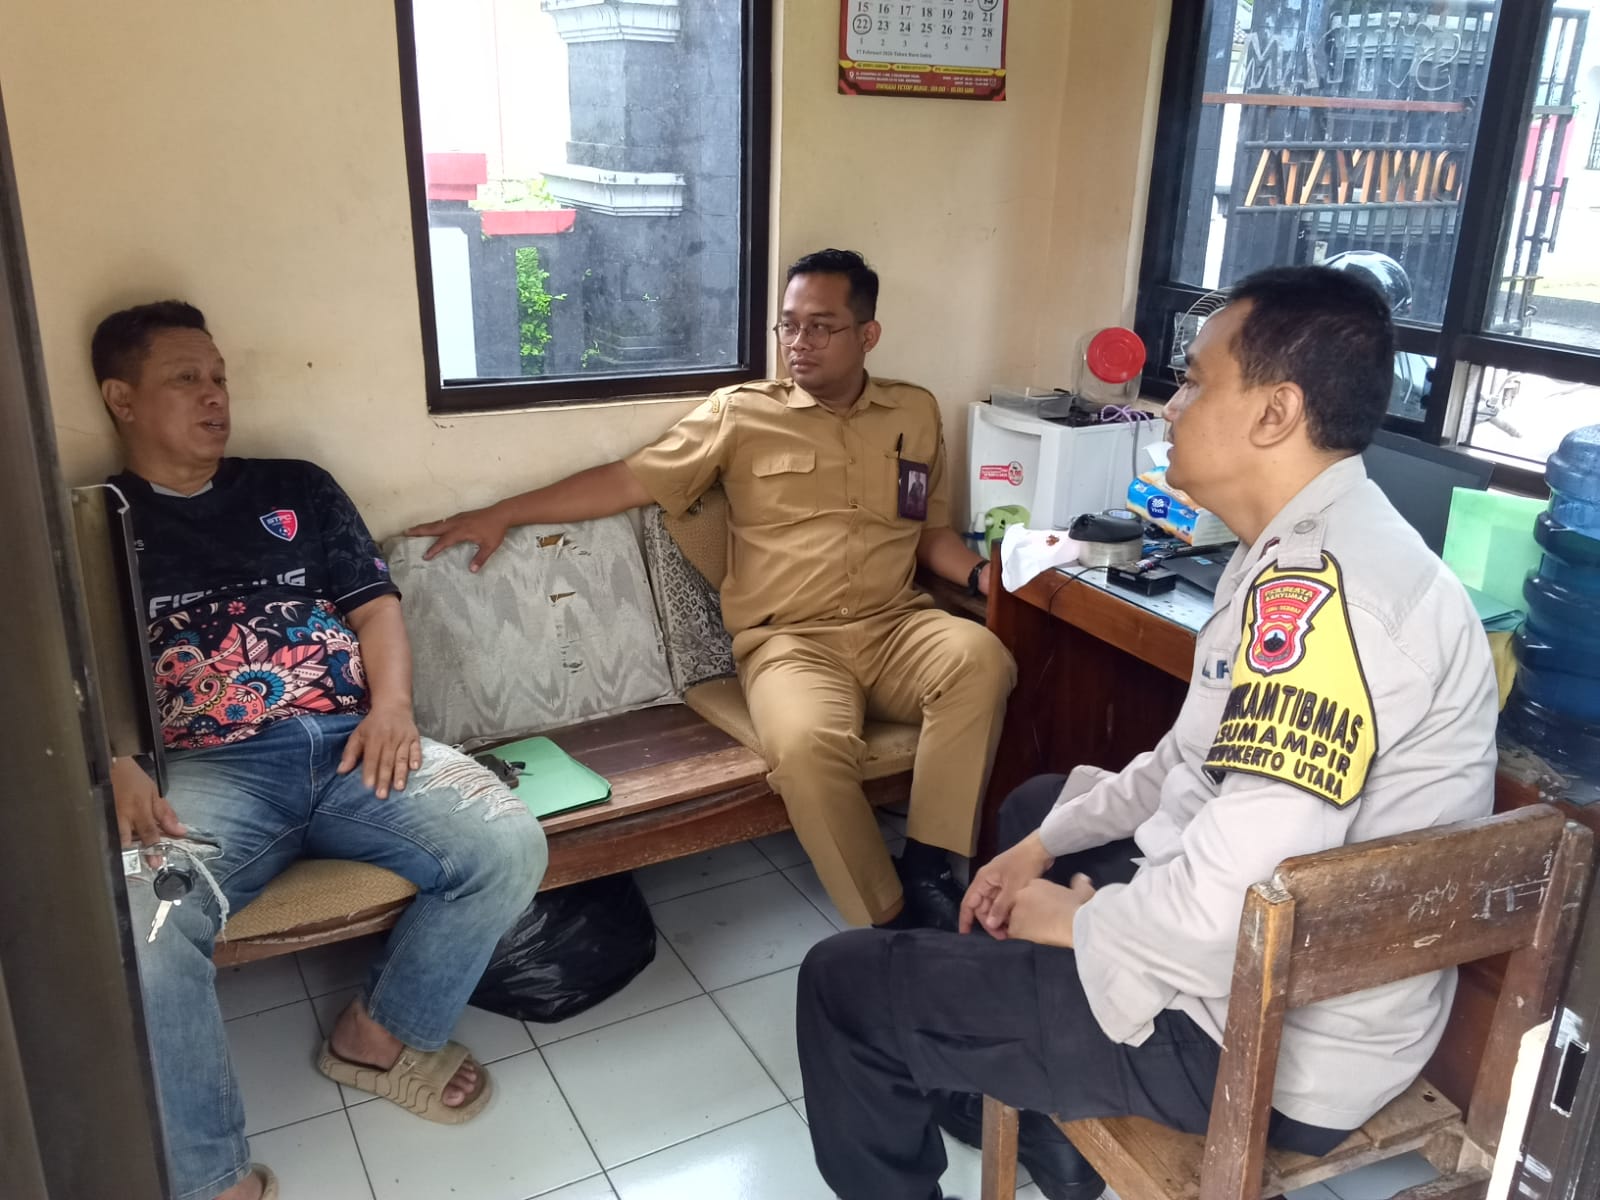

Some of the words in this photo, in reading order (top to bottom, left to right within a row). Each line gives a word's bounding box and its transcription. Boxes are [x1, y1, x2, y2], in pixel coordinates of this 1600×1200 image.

[858, 2, 869, 12] 15
[879, 3, 890, 14] 16
[900, 5, 912, 16] 17
[921, 7, 933, 17] 18
[942, 8, 953, 19] 19
[962, 10, 974, 20] 20
[982, 12, 993, 22] 21
[856, 19, 868, 29] 22
[878, 20, 889, 31] 23
[899, 22, 911, 32] 24
[921, 23, 933, 33] 25
[941, 24, 953, 35] 26
[962, 26, 973, 36] 27
[981, 27, 993, 38] 28
[1294, 758, 1343, 800] UTARA
